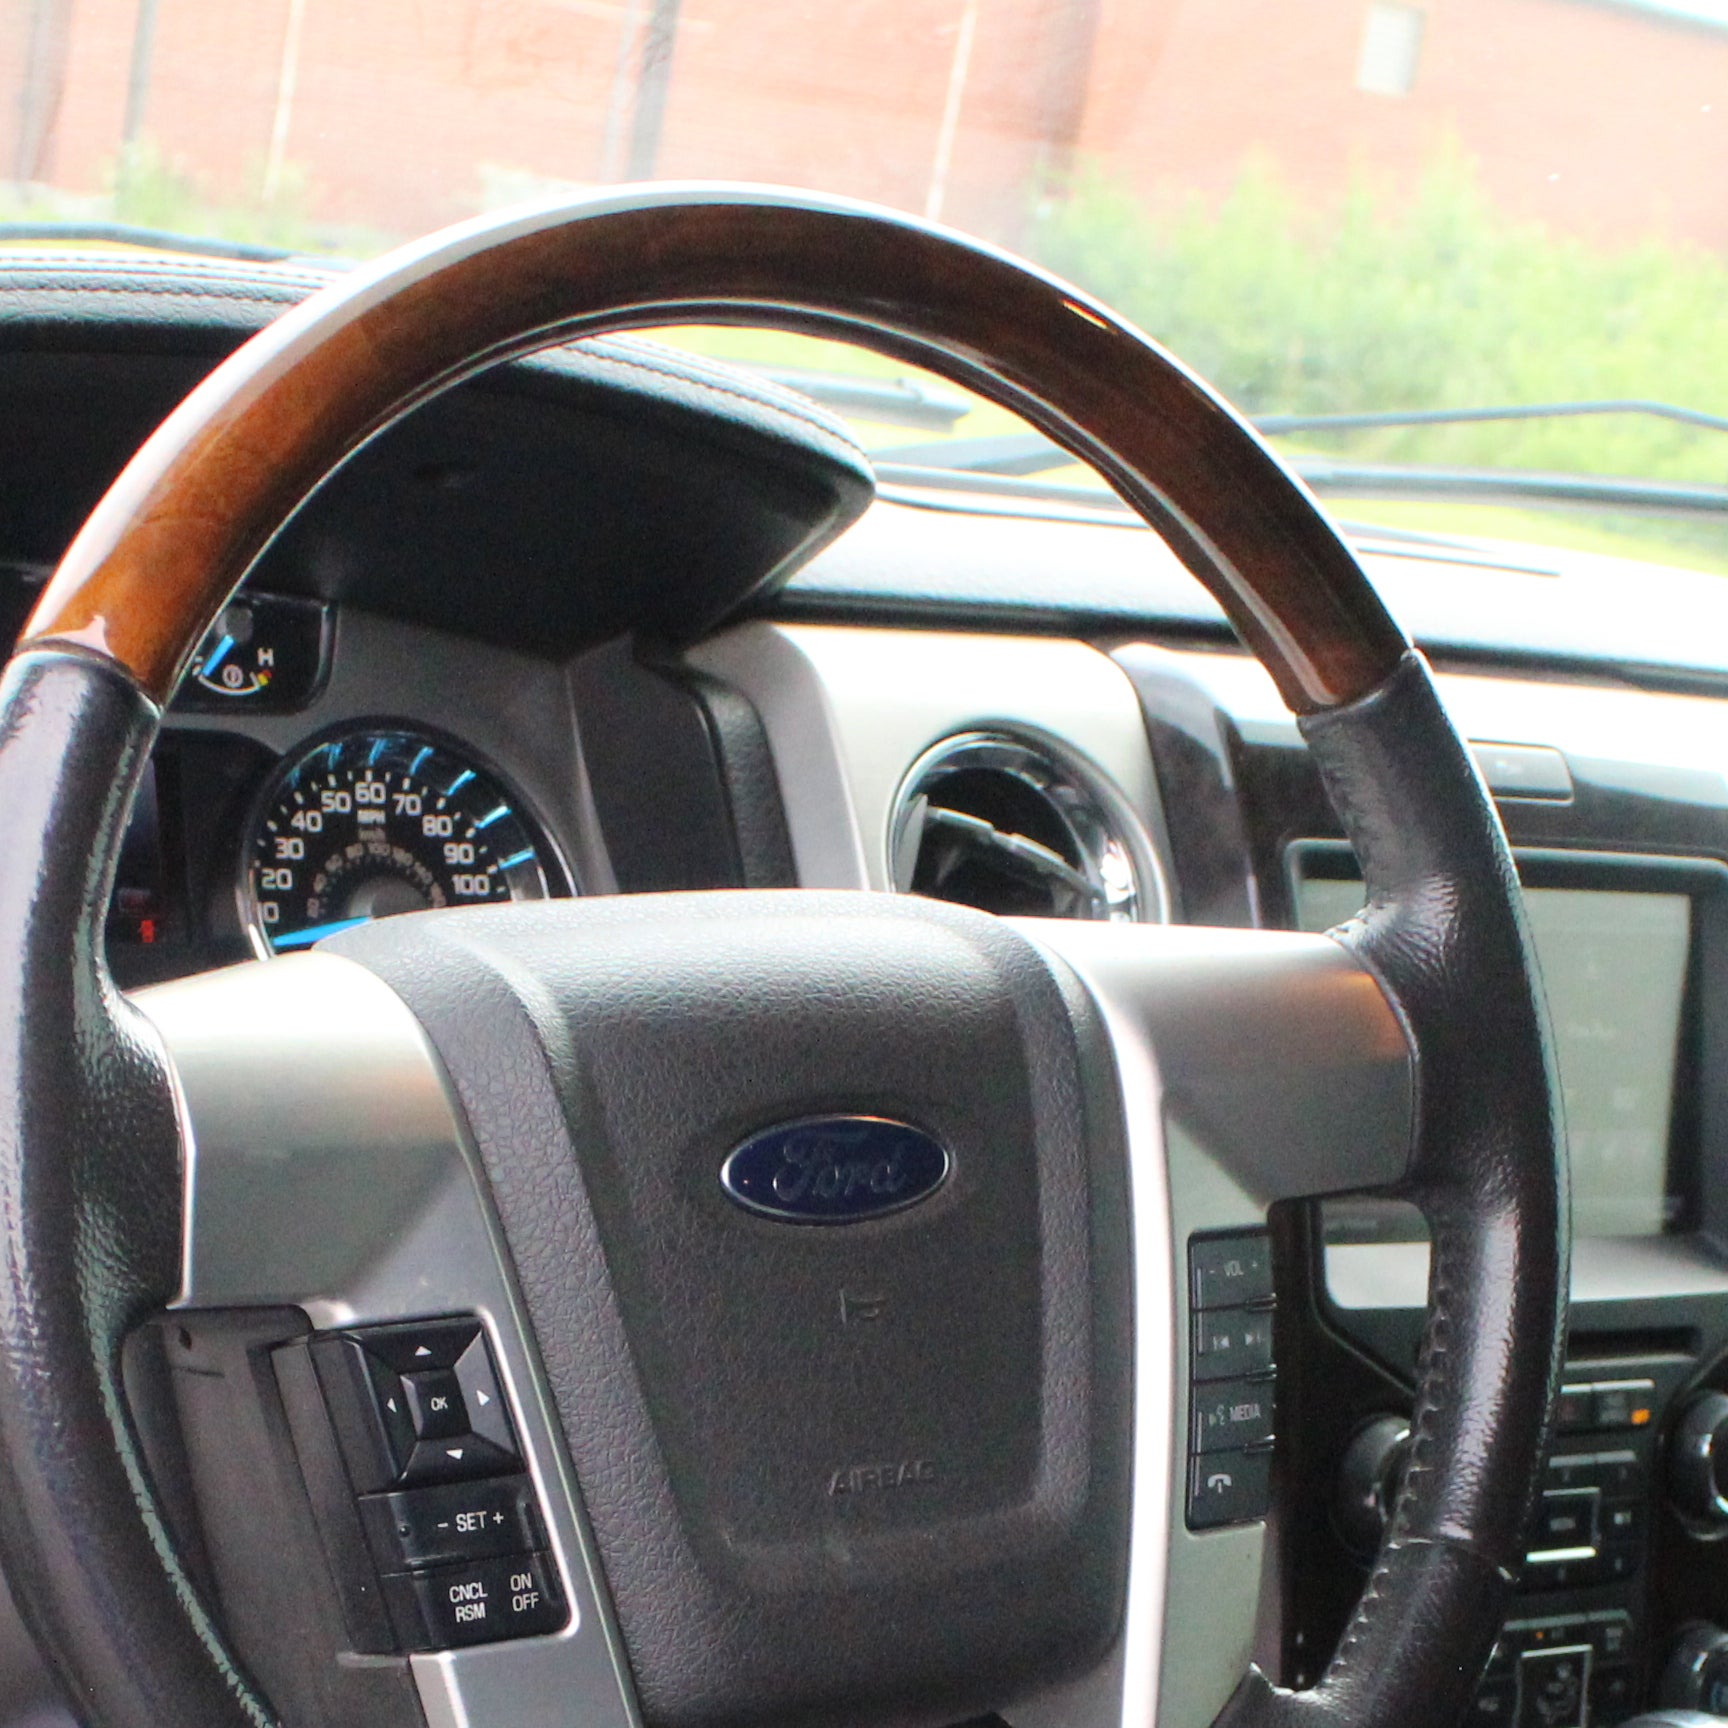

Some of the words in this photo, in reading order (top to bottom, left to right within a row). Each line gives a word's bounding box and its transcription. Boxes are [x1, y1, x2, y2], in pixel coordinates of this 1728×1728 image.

[257, 648, 274, 667] H
[321, 791, 352, 814] 50
[354, 782, 386, 804] 60
[392, 794, 422, 816] 70
[290, 810, 323, 833] 40
[422, 815, 453, 838] 80
[274, 838, 305, 860] 30
[443, 844, 475, 865] 90
[261, 868, 293, 890] 20
[451, 874, 490, 896] 100
[1224, 1260, 1244, 1277] VOL
[430, 1396, 449, 1411] OK
[1229, 1403, 1262, 1421] MEDIA
[455, 1511, 487, 1532] SET
[449, 1580, 488, 1603] CNCL
[510, 1573, 533, 1591] ON
[512, 1592, 540, 1612] OFF
[455, 1603, 486, 1623] RSM
